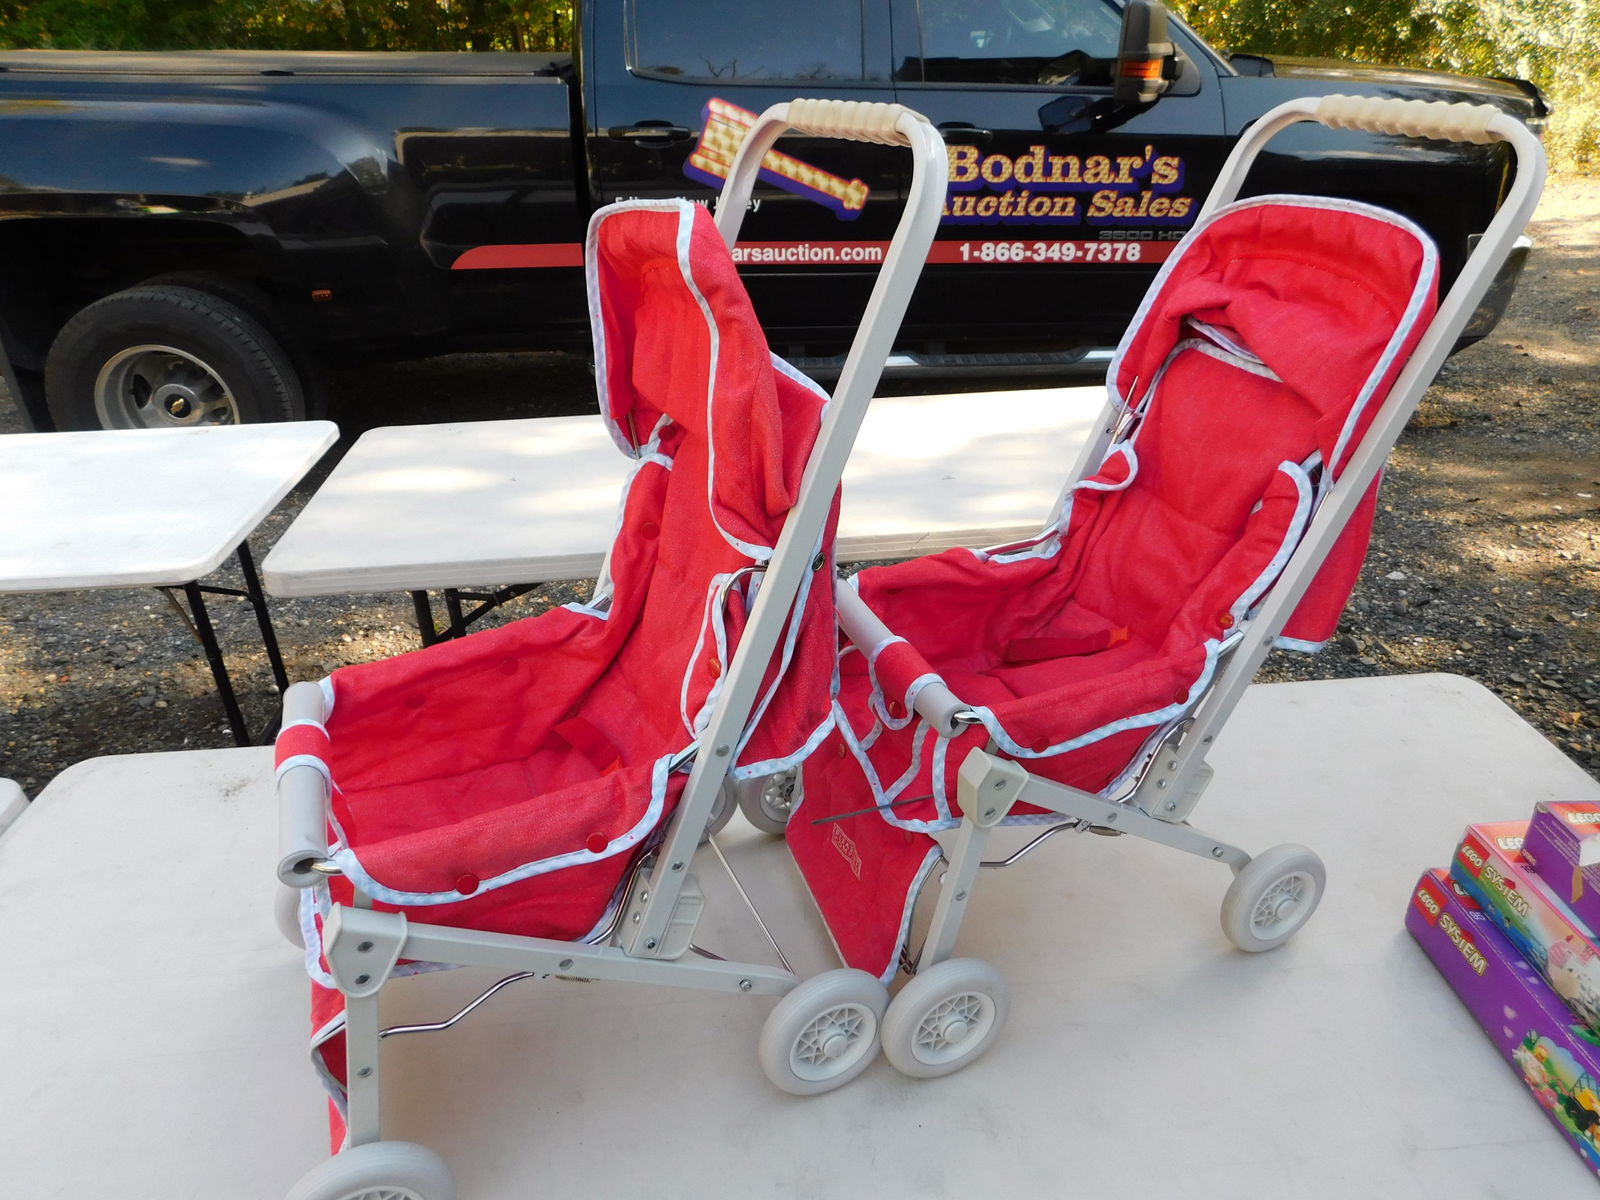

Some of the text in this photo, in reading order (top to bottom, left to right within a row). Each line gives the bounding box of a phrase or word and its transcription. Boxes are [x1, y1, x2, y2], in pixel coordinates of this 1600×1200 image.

[946, 144, 1180, 184] Bodnar's
[1087, 189, 1193, 217] Sales
[1098, 230, 1154, 240] 3500
[731, 243, 1141, 262] arsauction.com 1-866-349-7378
[1495, 837, 1524, 851] LEG
[1461, 844, 1483, 867] LEGO
[1484, 865, 1530, 917] SYSTEM
[1417, 888, 1440, 917] LEGO
[1438, 912, 1488, 976] SYSTEM
